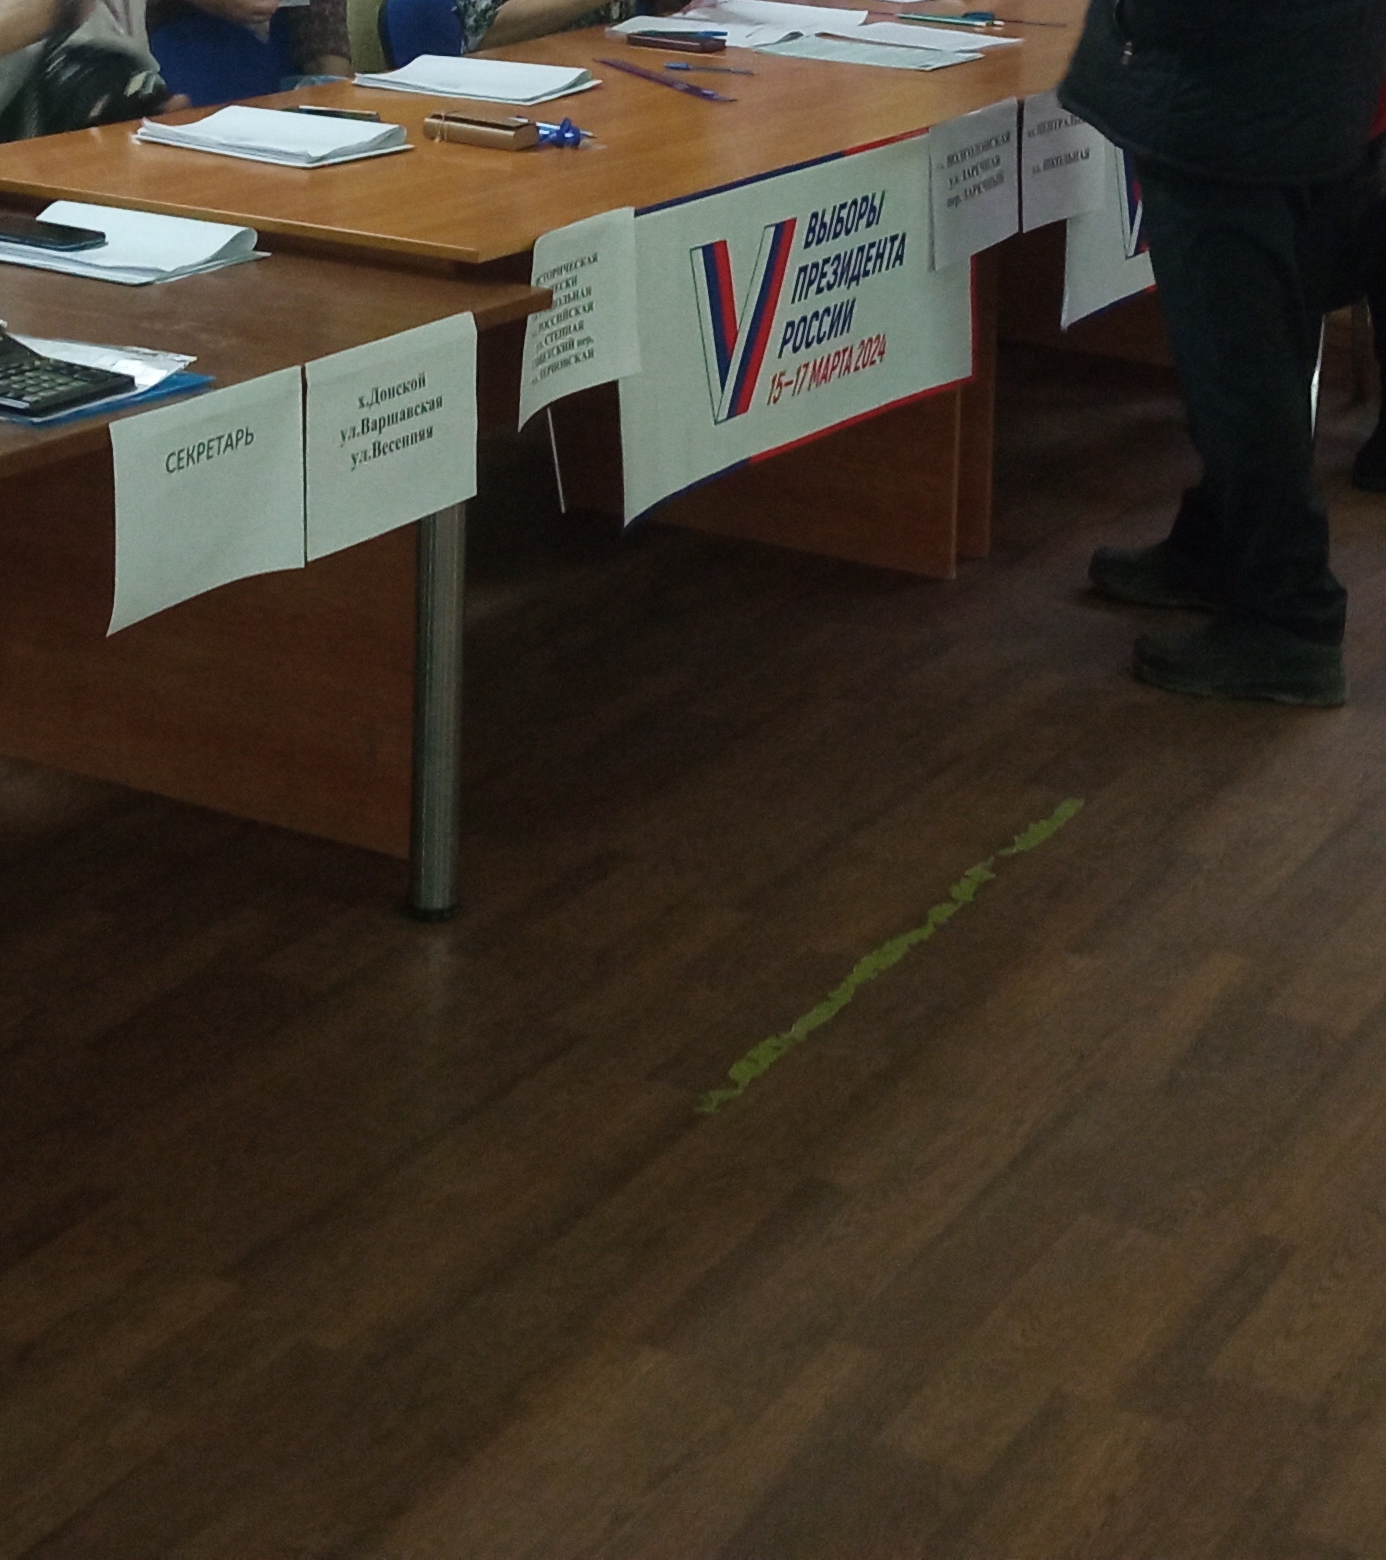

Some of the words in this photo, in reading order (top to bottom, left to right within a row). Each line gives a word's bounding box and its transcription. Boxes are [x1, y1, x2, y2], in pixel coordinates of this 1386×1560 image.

[803, 190, 886, 250] ВЫБОРЫ
[791, 231, 907, 305] ПРЕЗИДЕНТА
[777, 296, 857, 360] РОССИИ
[807, 344, 854, 392] МАРТА
[853, 332, 887, 374] 2024
[164, 425, 255, 474] СЕКРЕТАРЬ
[339, 394, 444, 448] ул.Варшавская
[349, 424, 435, 472] ул.Весенняя
